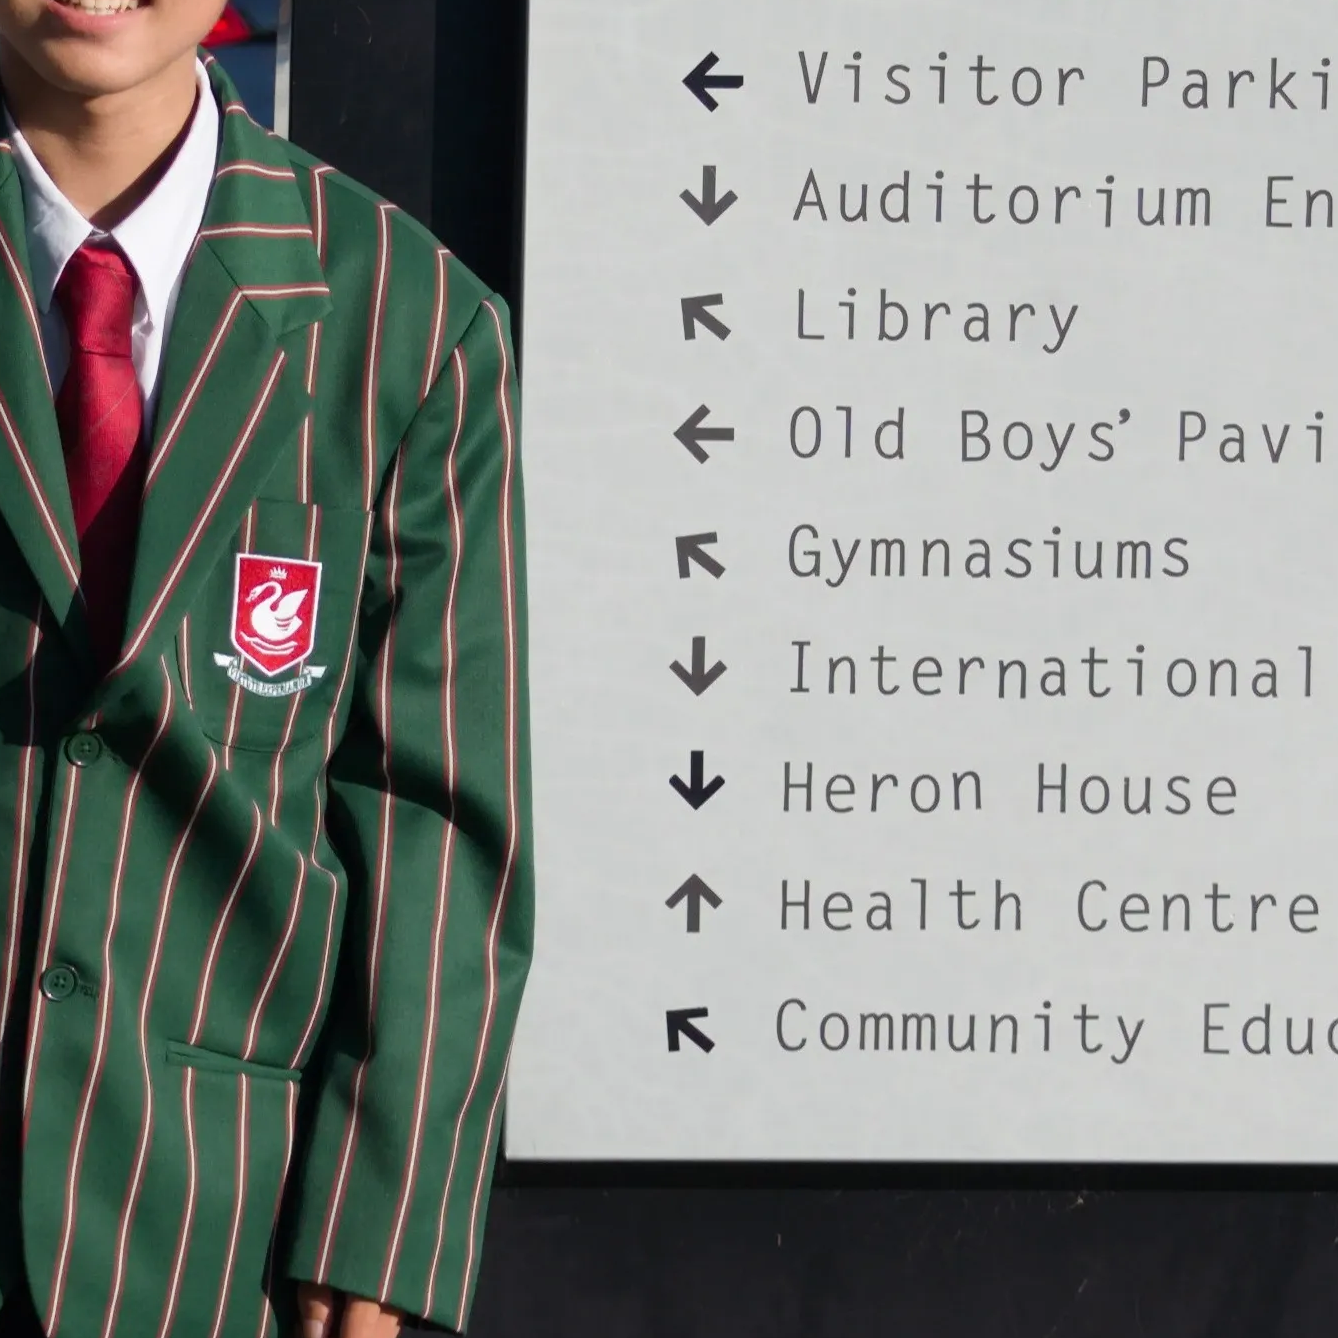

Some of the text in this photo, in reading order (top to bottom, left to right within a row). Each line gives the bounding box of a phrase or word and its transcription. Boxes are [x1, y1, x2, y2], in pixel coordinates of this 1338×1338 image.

[798, 51, 1085, 107] Visitor
[792, 168, 1211, 228] Auditorium
[797, 287, 1080, 354] Library
[790, 405, 906, 460] Old
[788, 523, 1190, 588] Gymnasiums
[790, 640, 1315, 699] International
[783, 761, 1238, 816] Heron House
[781, 878, 1320, 933] Health Centre
[776, 998, 1145, 1065] Community
